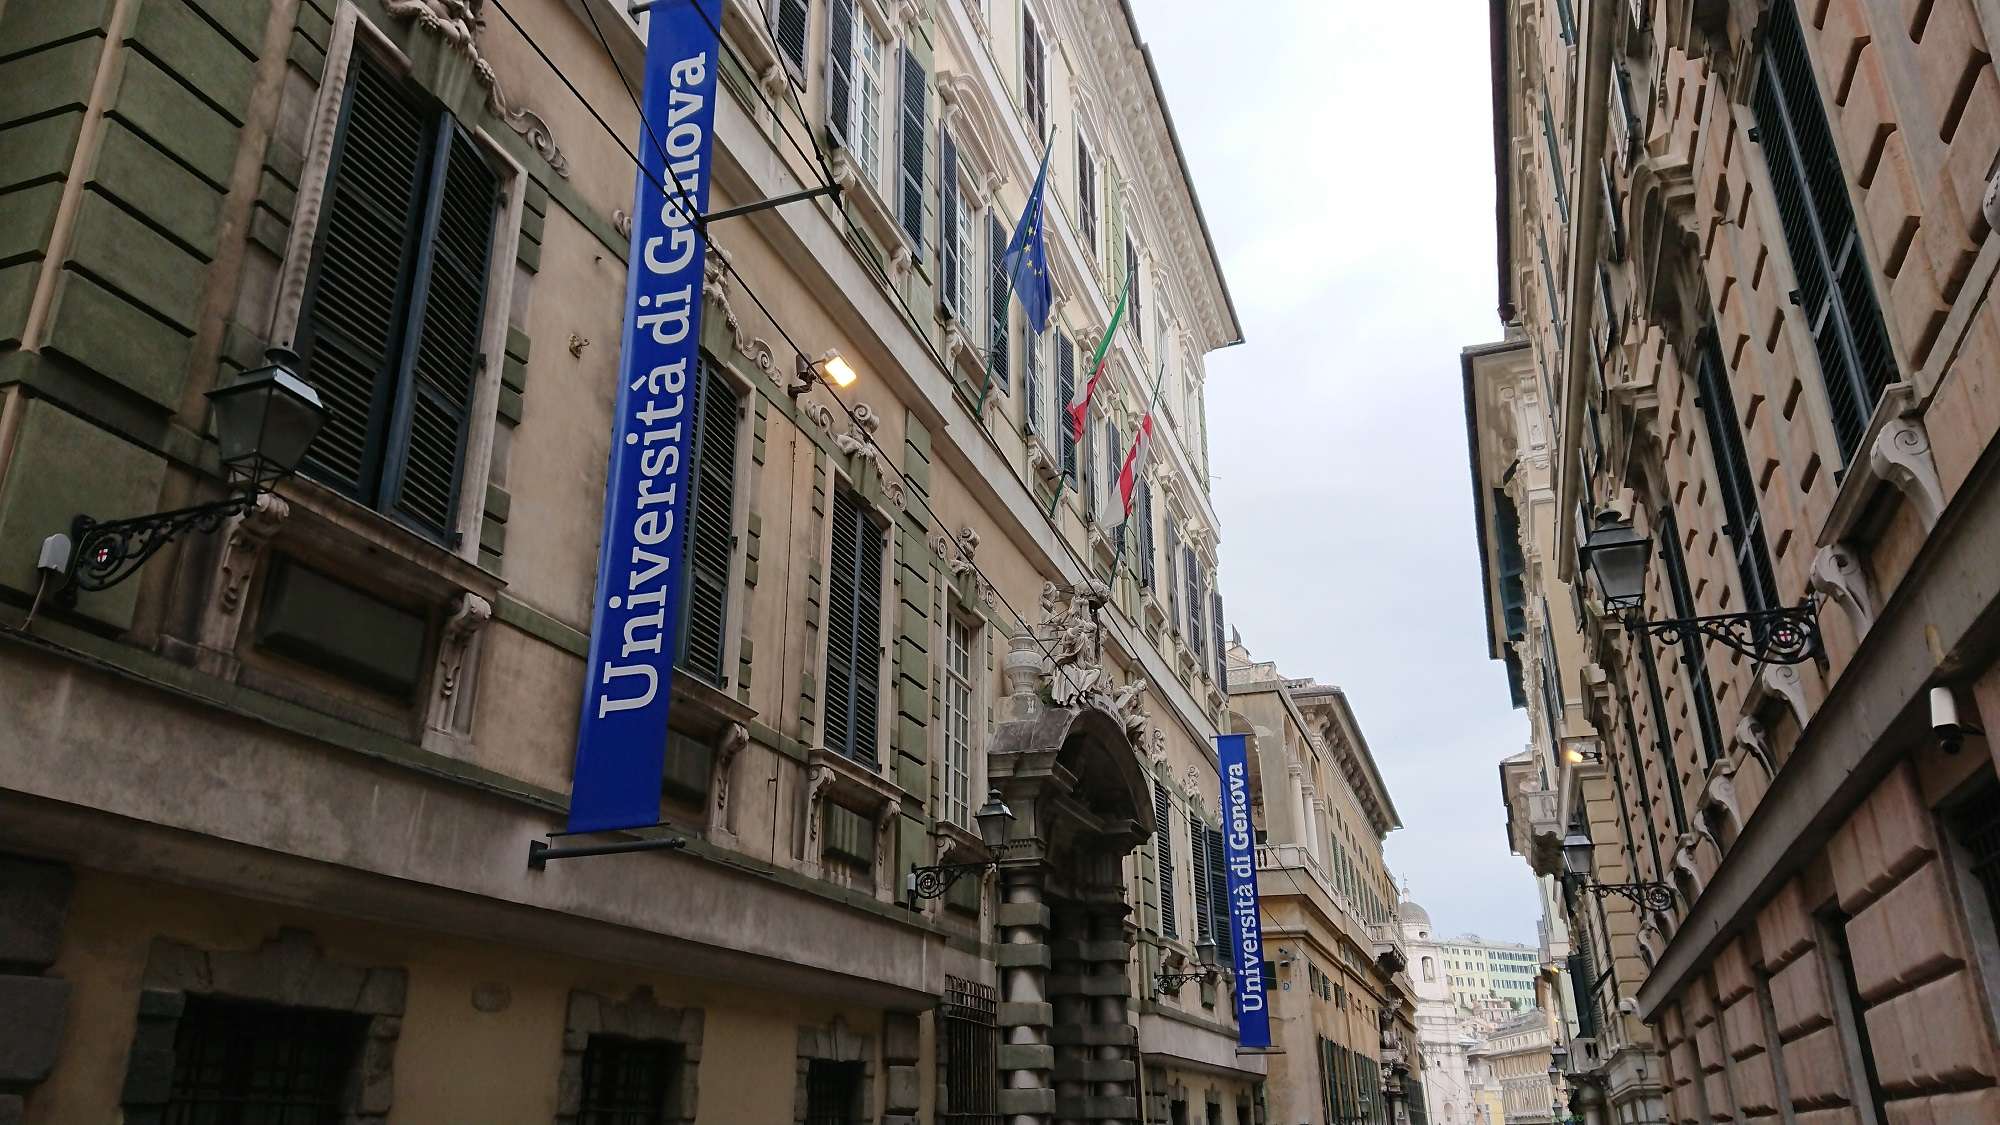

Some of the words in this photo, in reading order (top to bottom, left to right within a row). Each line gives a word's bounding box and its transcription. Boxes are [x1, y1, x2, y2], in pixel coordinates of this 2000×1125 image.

[644, 51, 706, 275] Genova
[637, 284, 692, 345] di
[598, 357, 687, 719] Università
[1228, 761, 1250, 850] Genova
[1230, 854, 1252, 878] di
[1232, 882, 1263, 1013] Università
